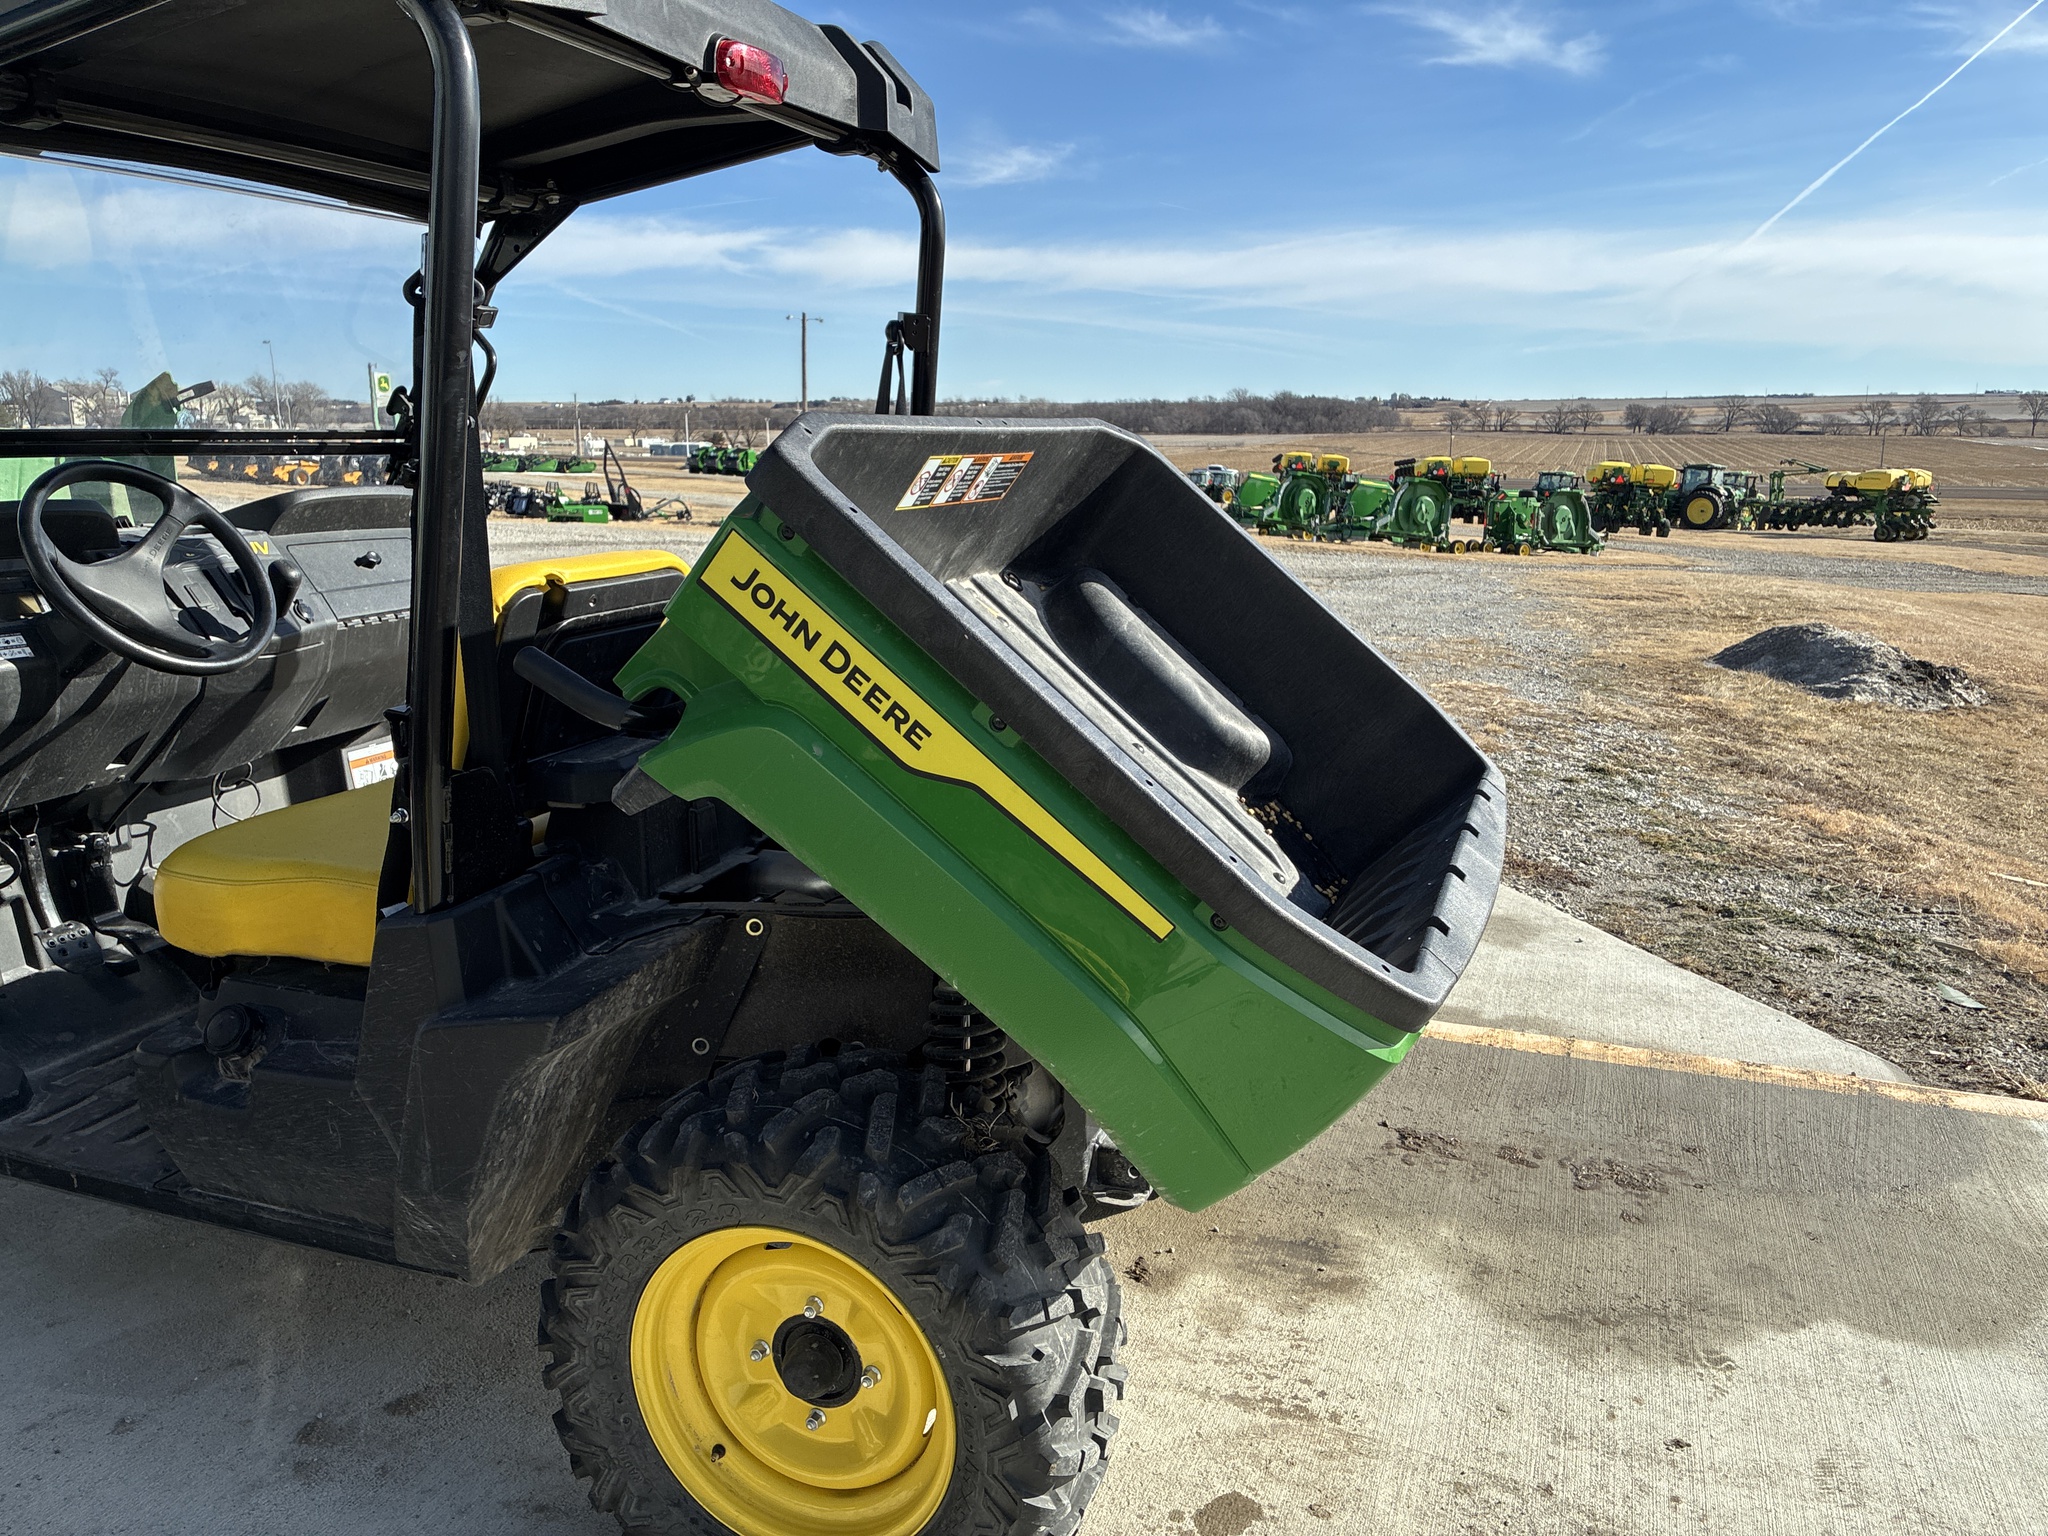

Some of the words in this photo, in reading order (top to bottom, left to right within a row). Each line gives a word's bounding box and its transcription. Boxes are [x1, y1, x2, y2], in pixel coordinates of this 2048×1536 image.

[149, 527, 173, 558] DEERE
[730, 568, 822, 652] JOHN
[819, 640, 932, 751] DEERE
